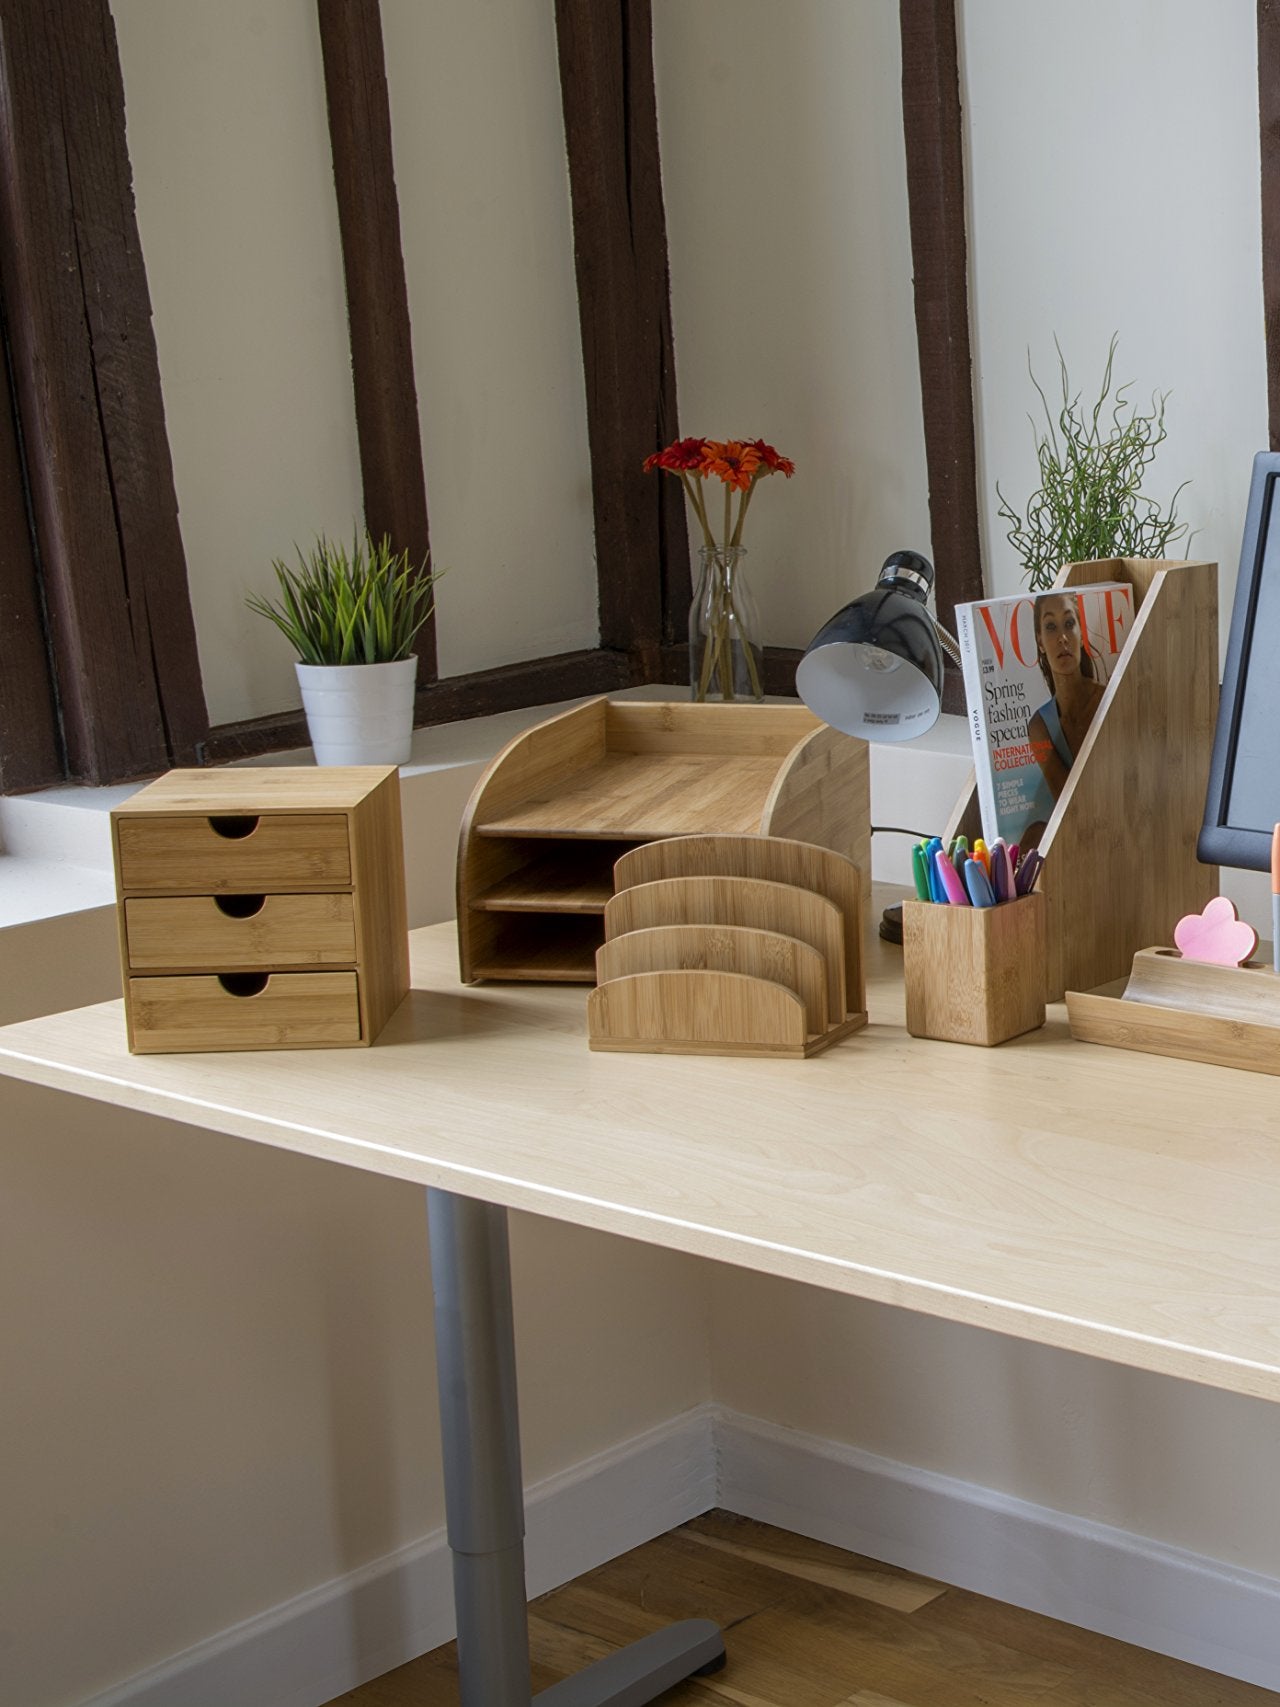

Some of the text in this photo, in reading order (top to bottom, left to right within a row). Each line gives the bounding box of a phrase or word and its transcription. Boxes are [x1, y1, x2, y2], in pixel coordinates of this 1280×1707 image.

[976, 588, 1130, 670] VOUE
[984, 678, 1026, 705] Spring
[972, 710, 982, 742] VOGUE
[988, 701, 1031, 724] fashion
[990, 718, 1030, 748] special
[994, 752, 1048, 772] COLLECTIO
